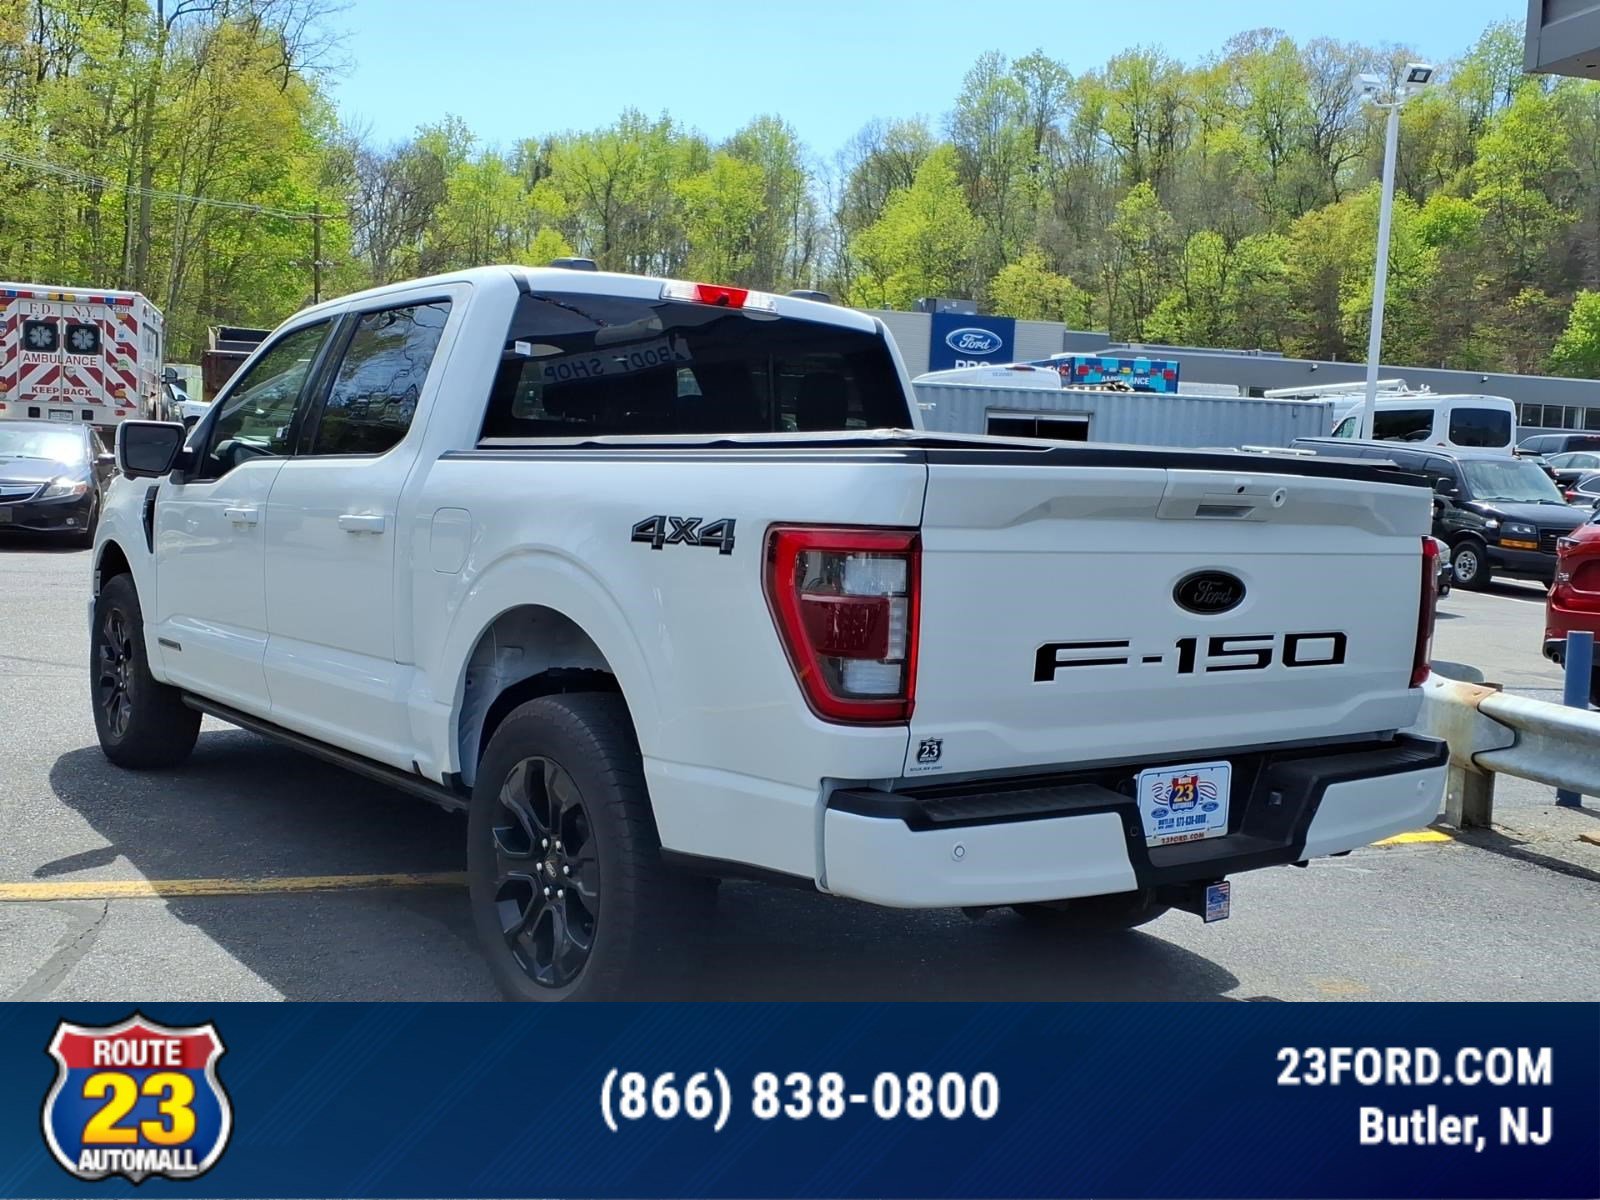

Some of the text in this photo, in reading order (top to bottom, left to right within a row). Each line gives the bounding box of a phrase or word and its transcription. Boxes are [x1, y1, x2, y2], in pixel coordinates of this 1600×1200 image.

[959, 333, 991, 350] Ford
[23, 353, 98, 367] AMBULANCE
[31, 386, 92, 397] KEEP BACK
[1193, 580, 1233, 604] Ford
[1033, 631, 1348, 683] F-150
[920, 744, 939, 758] 23
[1174, 785, 1194, 802] 23
